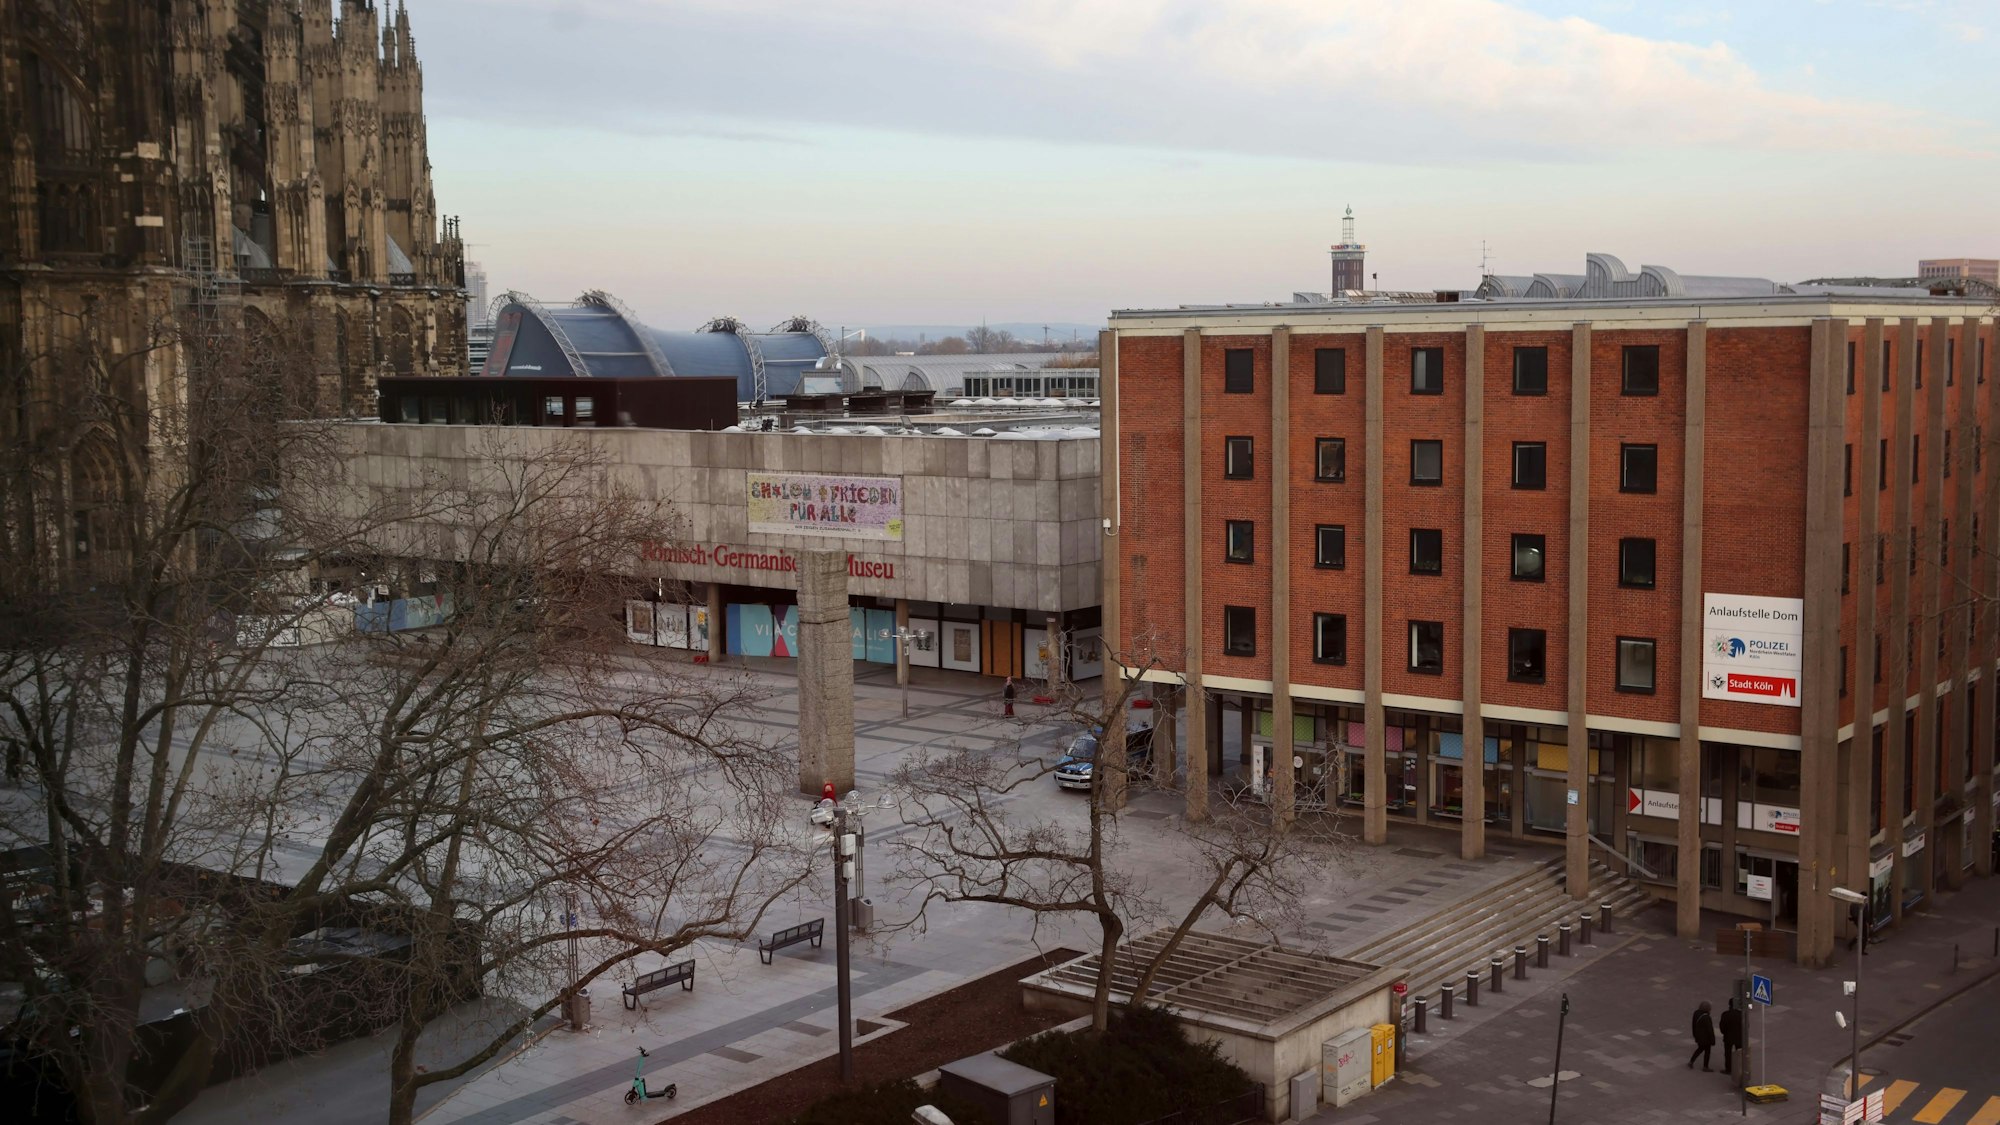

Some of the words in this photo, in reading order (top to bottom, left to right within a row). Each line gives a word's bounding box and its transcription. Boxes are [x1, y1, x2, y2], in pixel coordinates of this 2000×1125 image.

[1709, 606, 1770, 619] Anlaufstelle
[1773, 610, 1798, 621] Dom
[1749, 640, 1789, 651] POLIZEI
[1729, 679, 1752, 689] Stadt
[1753, 681, 1774, 691] Köln
